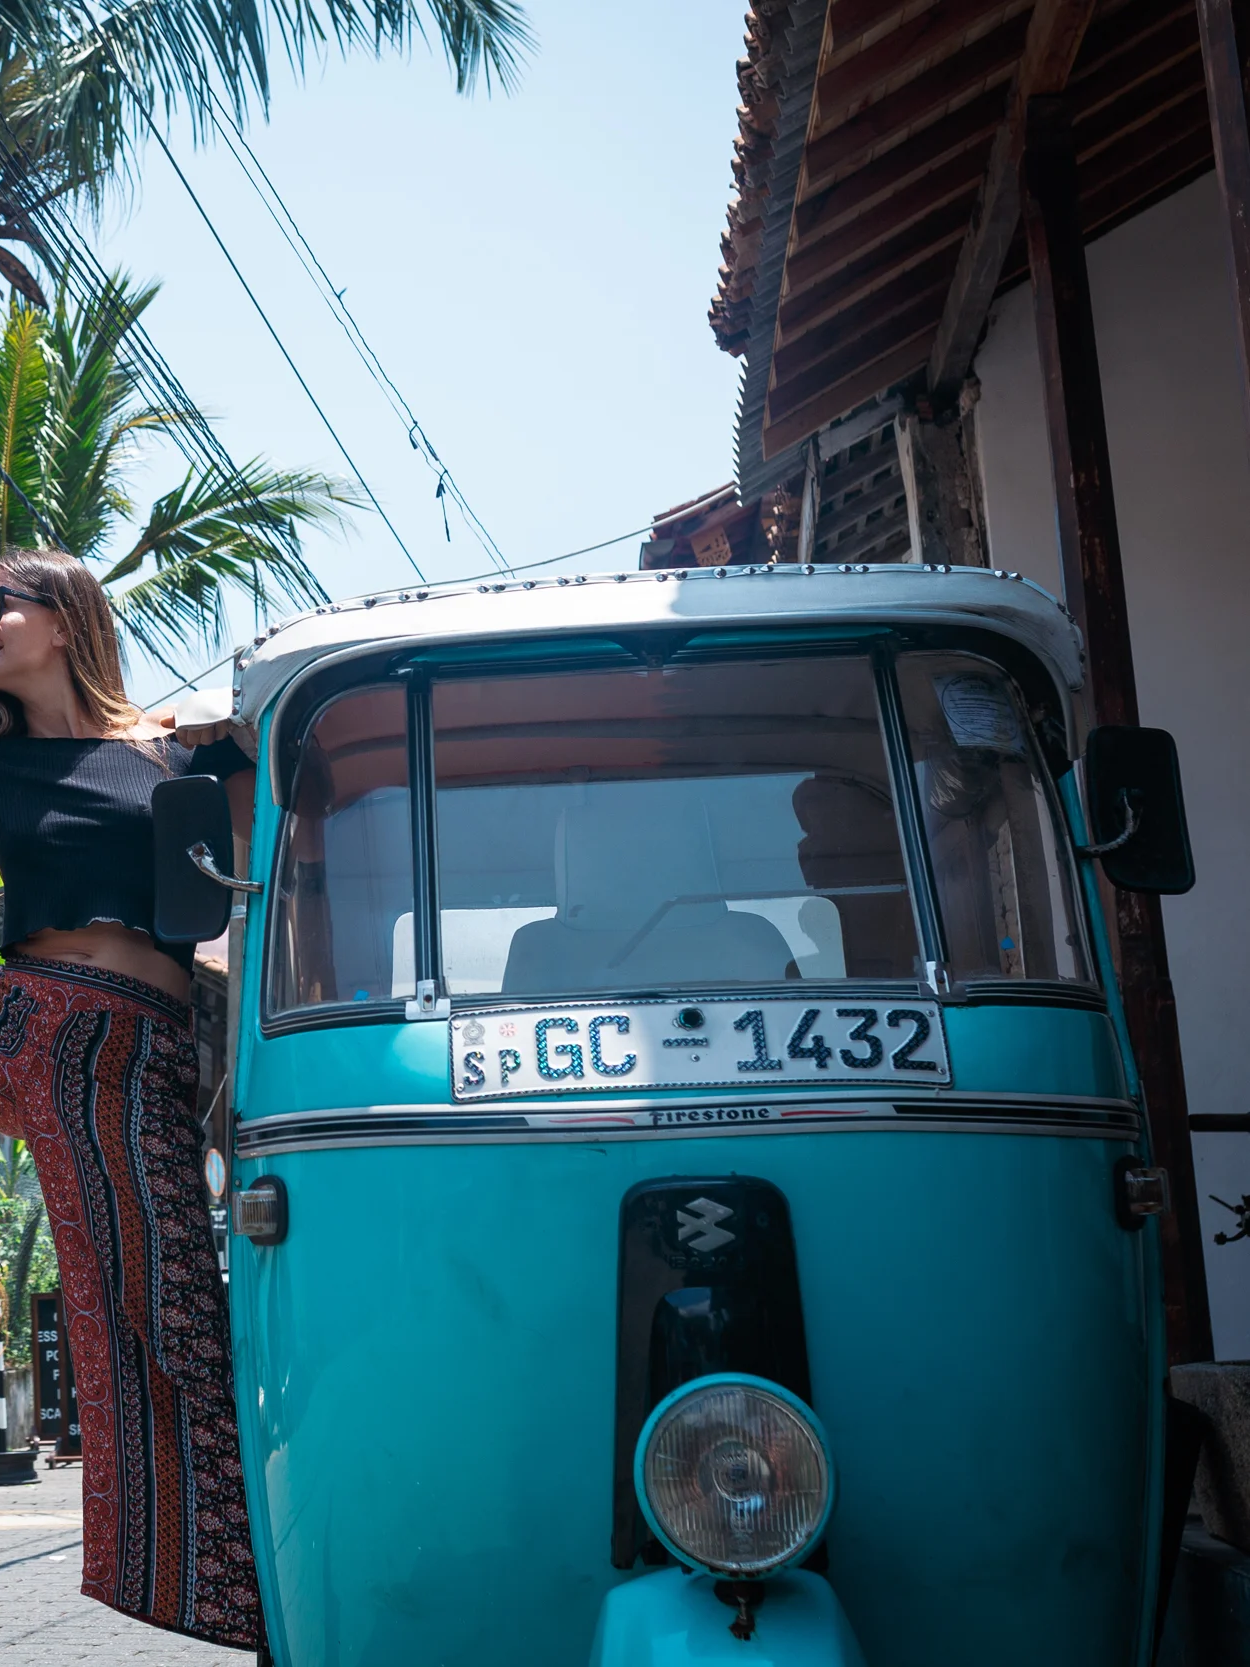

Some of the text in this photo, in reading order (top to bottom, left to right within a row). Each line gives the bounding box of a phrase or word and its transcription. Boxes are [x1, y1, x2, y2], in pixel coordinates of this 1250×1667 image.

[536, 1015, 637, 1081] GC
[733, 1008, 937, 1072] 1432
[649, 1107, 770, 1126] Firestone
